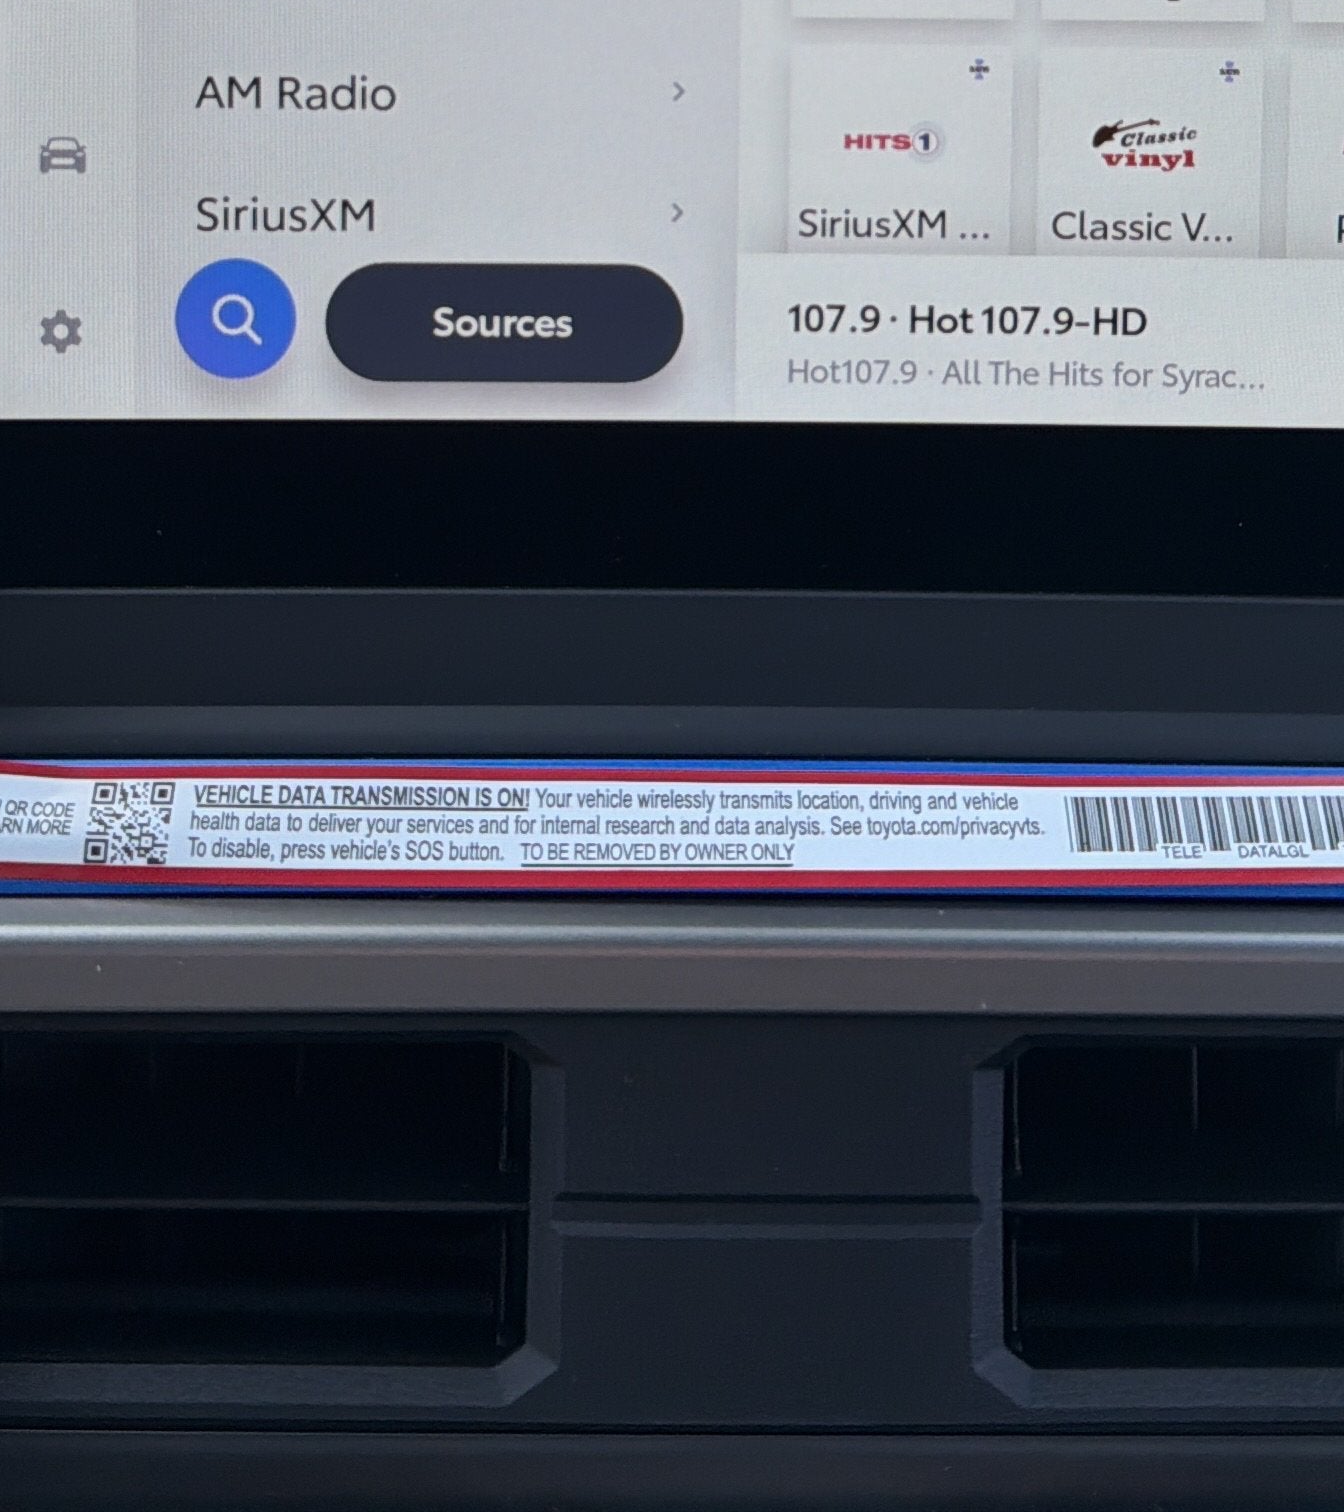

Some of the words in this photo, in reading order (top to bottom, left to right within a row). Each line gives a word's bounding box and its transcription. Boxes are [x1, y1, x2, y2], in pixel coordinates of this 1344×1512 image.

[195, 75, 262, 112] AM
[278, 74, 397, 114] Radio
[843, 134, 912, 150] HITS
[1120, 125, 1198, 147] Classic
[1101, 148, 1196, 172] vinyl
[195, 195, 376, 235] SiriusXM
[797, 208, 948, 239] SiriusXM
[1051, 211, 1172, 241] Classic
[432, 305, 574, 341] Sources
[788, 304, 881, 333] 107.9
[909, 305, 973, 334] Hot
[982, 306, 1148, 336] 107.9-HD
[788, 358, 918, 384] Hot107.9
[942, 359, 981, 385] All
[989, 360, 1039, 386] The
[1049, 361, 1104, 387] Hits
[1113, 361, 1153, 388] for
[5, 800, 28, 817] QR
[31, 801, 76, 818] CODE
[194, 785, 273, 805] VEHICLE
[279, 785, 326, 805] DATA
[331, 785, 470, 806] TRANSMISSION
[475, 787, 492, 807] IS
[498, 788, 530, 807] ON!
[535, 788, 572, 808] Your
[577, 788, 632, 808] vehicle
[638, 789, 715, 813] wirelessly
[720, 790, 792, 809] transmits
[798, 790, 864, 812] location,
[869, 791, 922, 814] driving
[928, 792, 957, 810] and
[963, 792, 1019, 811] vehicle
[26, 819, 72, 835] MORE
[190, 811, 240, 831] health
[245, 812, 281, 831] data
[287, 813, 302, 832] to
[309, 813, 362, 833] deliver
[366, 817, 403, 837] your
[407, 815, 474, 835] services
[479, 815, 509, 835] and
[515, 815, 536, 835] for
[541, 816, 600, 835] internal
[606, 816, 675, 835] research
[680, 816, 710, 835] and
[715, 816, 750, 835] data
[755, 816, 825, 840] analysis.
[831, 816, 862, 835] See
[867, 816, 1046, 840] toyota.com/privacyvts.
[189, 837, 206, 858] To
[212, 838, 275, 862] disable,
[280, 844, 326, 863] press
[406, 840, 444, 861] SOS
[449, 841, 505, 861] button.
[520, 843, 543, 861] TO
[548, 843, 569, 861] BE
[574, 843, 656, 861] REMOVED
[660, 844, 682, 861] BY
[685, 844, 748, 861] OWNER
[751, 844, 795, 861] ONLY
[1161, 845, 1203, 859] TELE
[1238, 844, 1310, 858] DATALGL
